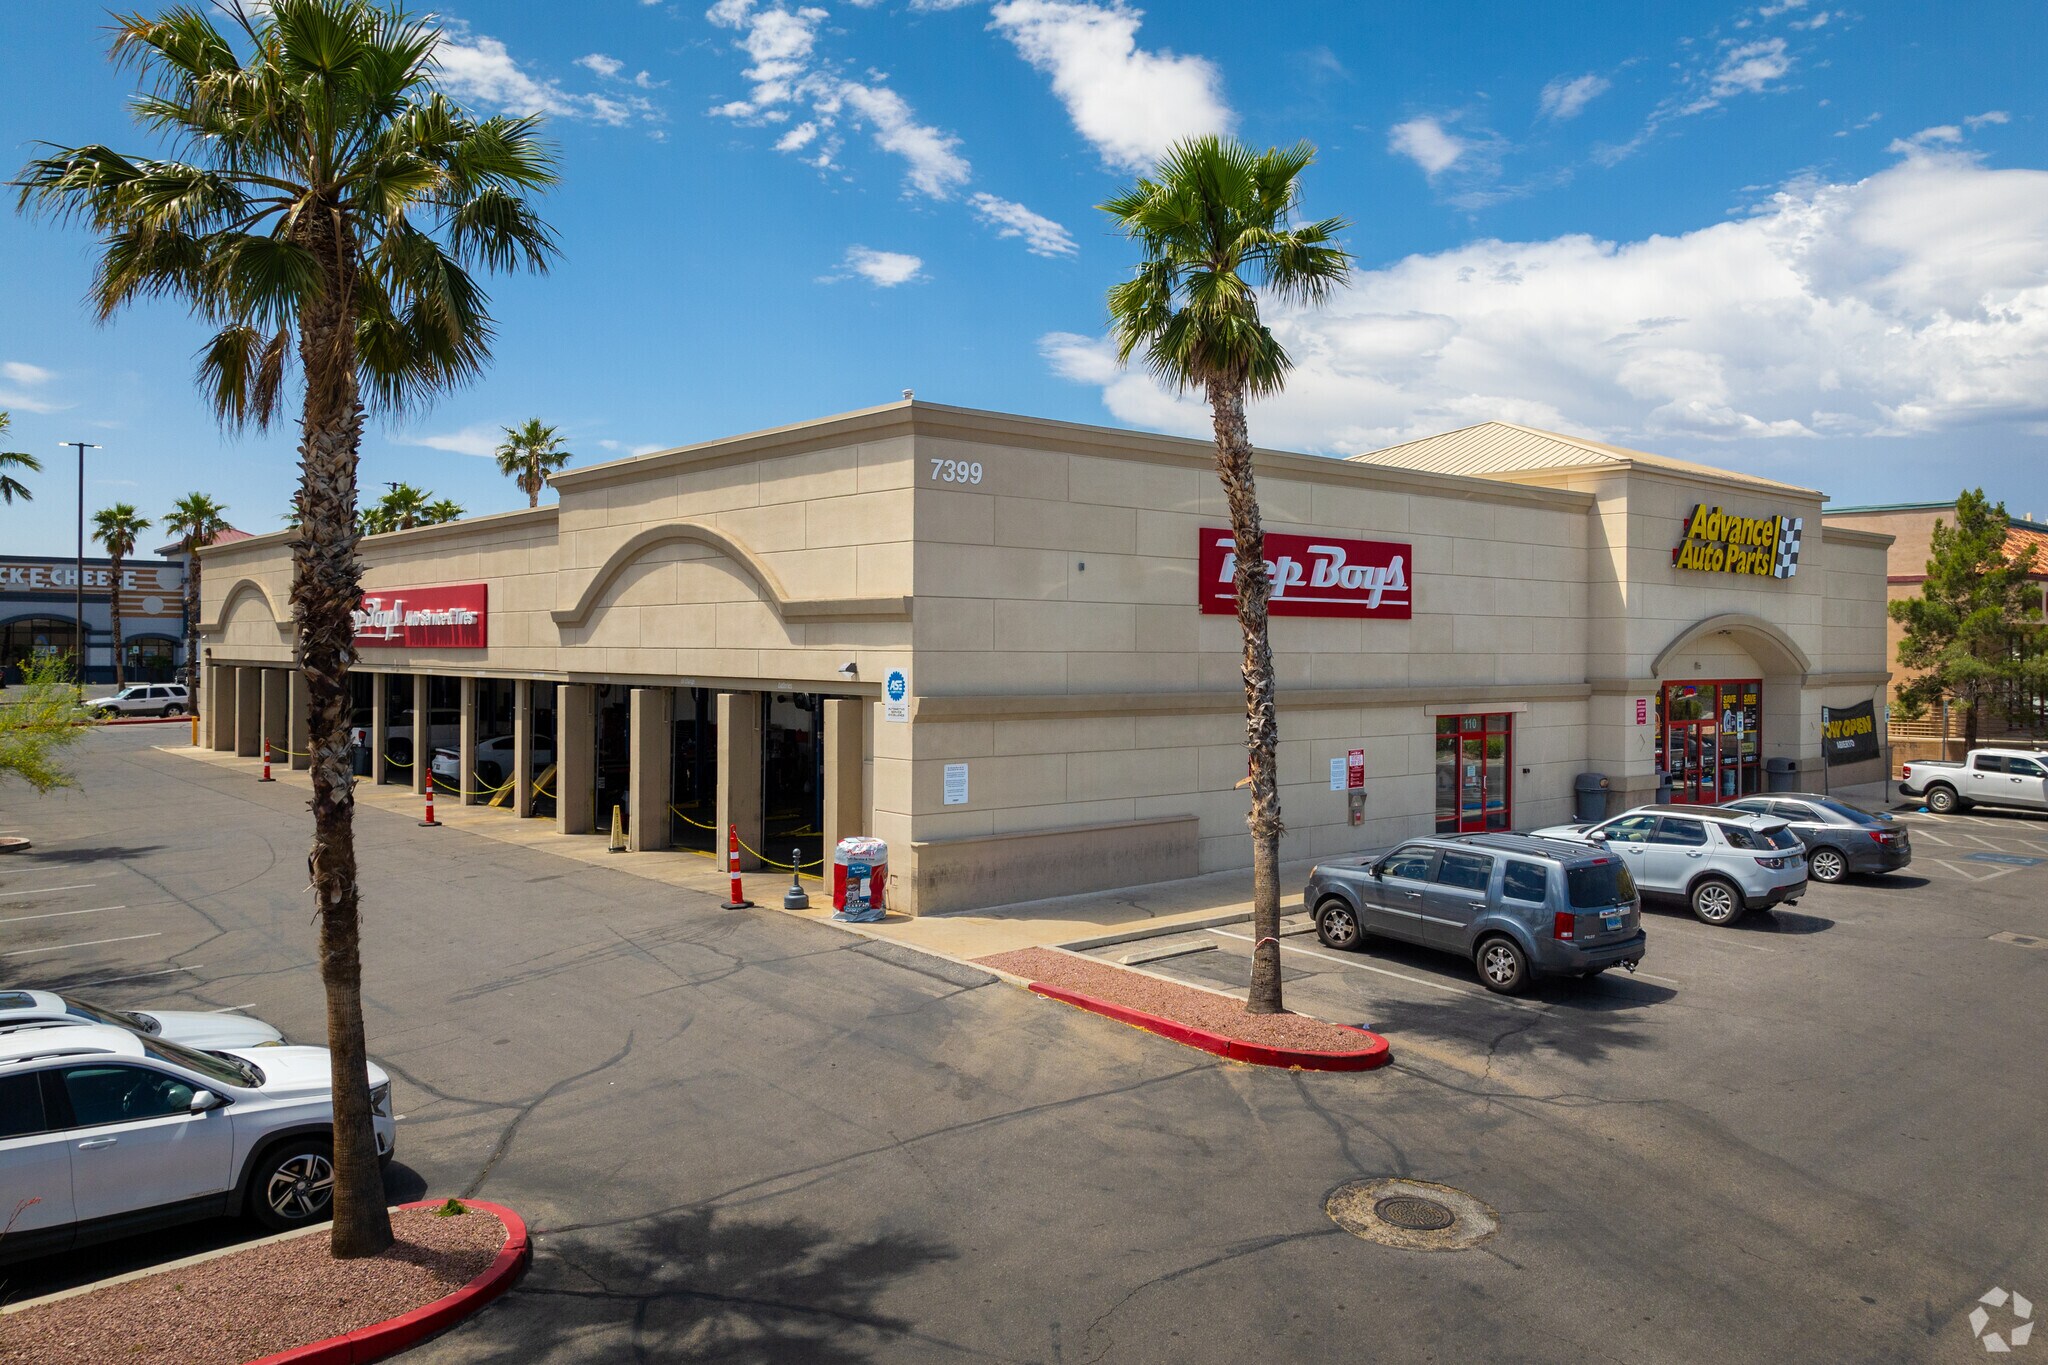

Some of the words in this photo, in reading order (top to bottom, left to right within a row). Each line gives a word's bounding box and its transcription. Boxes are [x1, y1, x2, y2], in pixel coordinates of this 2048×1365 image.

[930, 458, 983, 485] 7399
[1685, 503, 1774, 547] Advance
[1675, 539, 1724, 571] Auto
[1724, 543, 1771, 576] Parts
[50, 569, 137, 590] CHEEE
[1306, 544, 1409, 609] Boys
[1464, 718, 1477, 729] 110
[1841, 715, 1873, 737] OPEN
